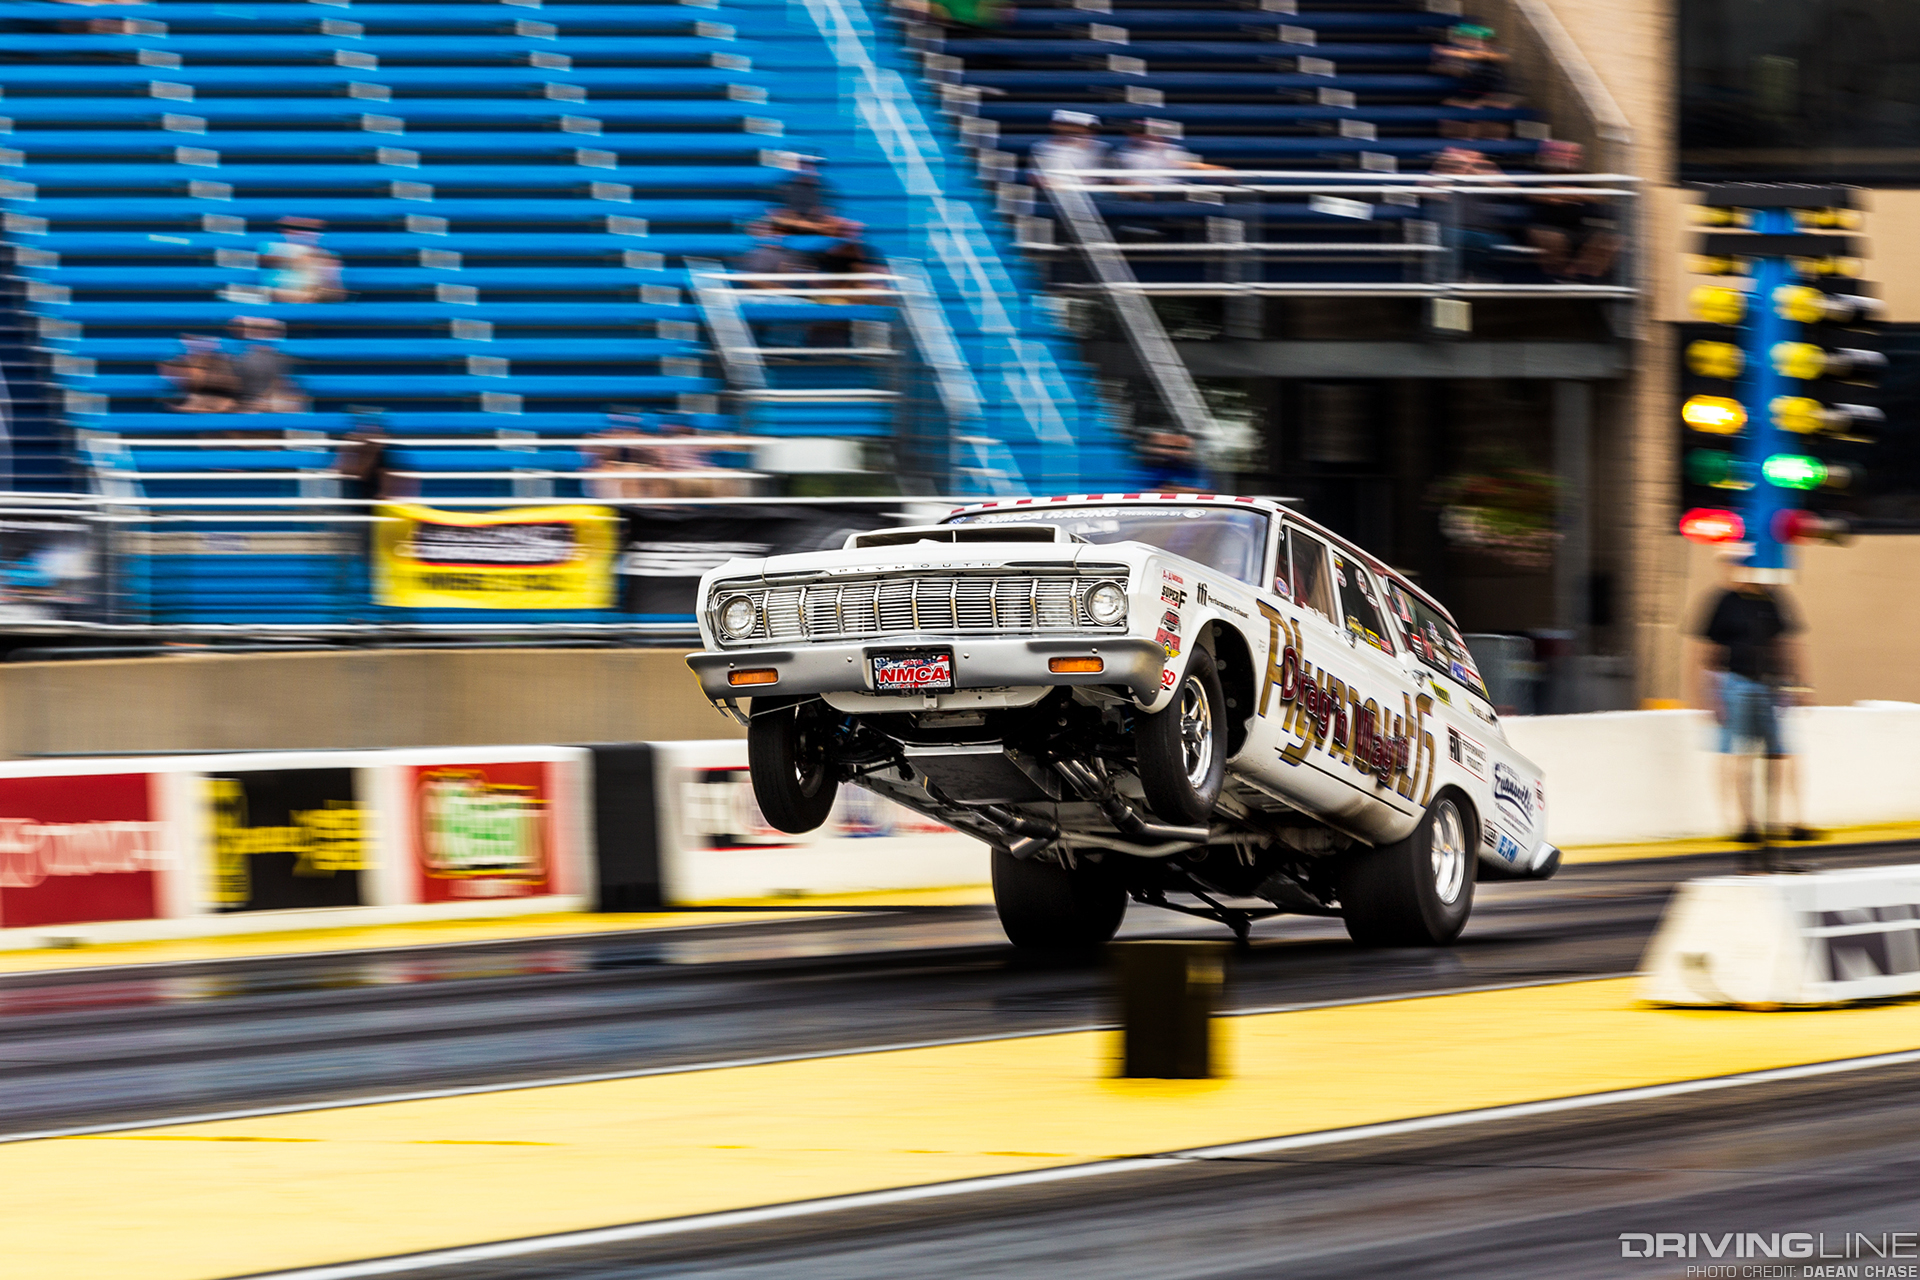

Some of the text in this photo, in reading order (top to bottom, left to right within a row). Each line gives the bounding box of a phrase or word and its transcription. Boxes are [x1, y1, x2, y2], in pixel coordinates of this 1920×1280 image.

[986, 512, 1043, 524] NMCA
[1047, 509, 1119, 519] RACING
[839, 563, 991, 573] PLYMOUTH
[1161, 585, 1180, 603] SUPER
[879, 667, 947, 682] NMCA
